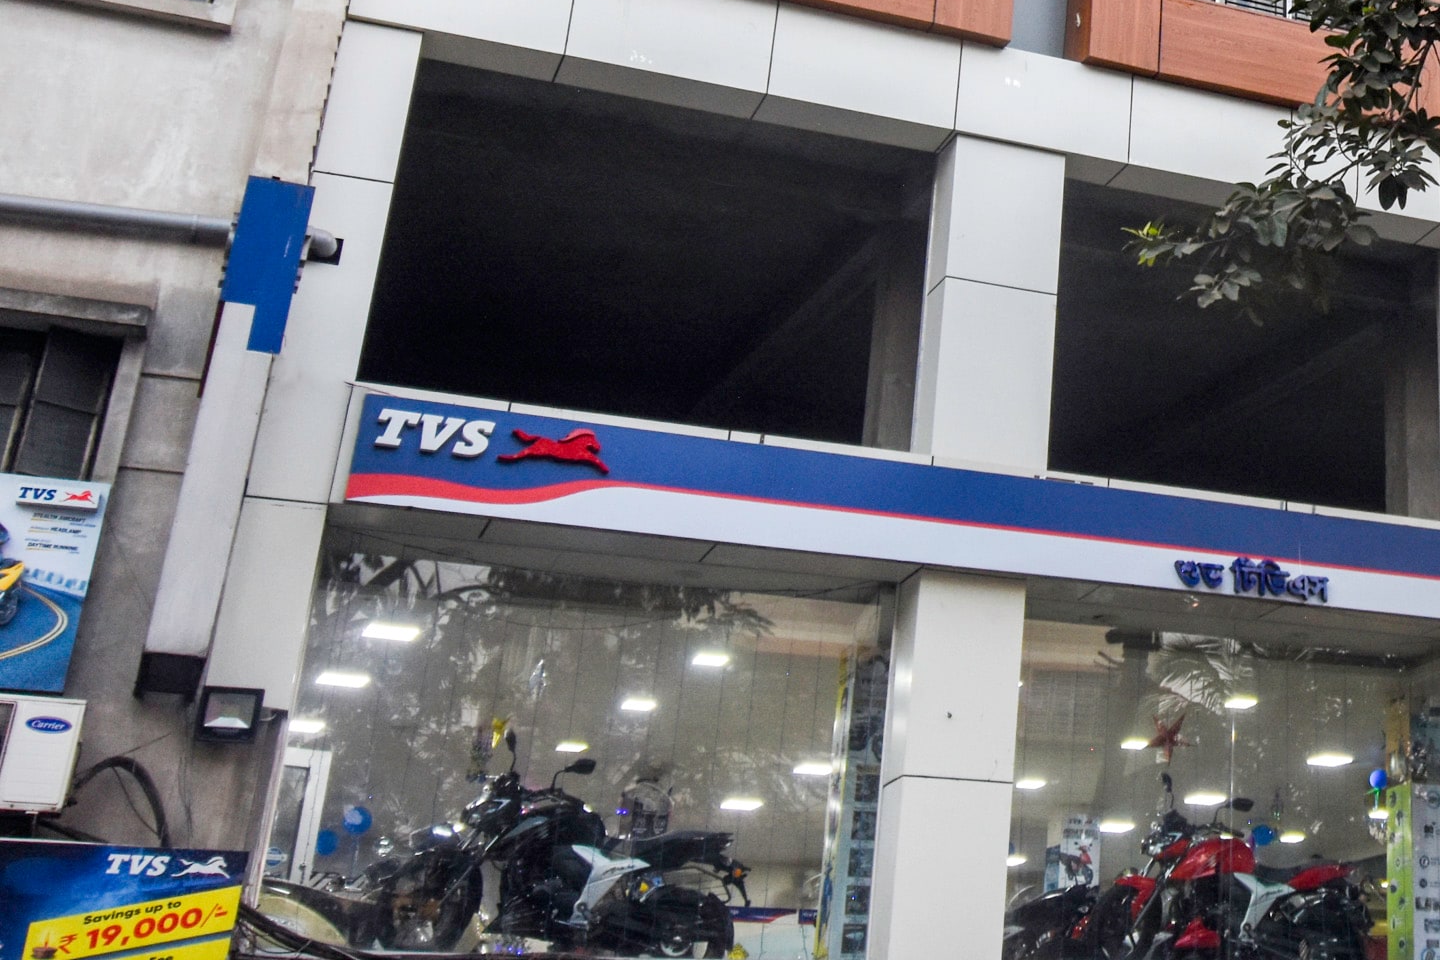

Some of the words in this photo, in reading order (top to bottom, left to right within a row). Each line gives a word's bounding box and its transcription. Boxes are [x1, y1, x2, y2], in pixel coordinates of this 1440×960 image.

[373, 407, 497, 459] TVS
[18, 486, 57, 501] TVS
[31, 720, 66, 730] Carrier
[105, 853, 170, 876] TVS
[83, 908, 141, 925] Savings
[144, 904, 163, 914] up
[167, 900, 182, 910] to
